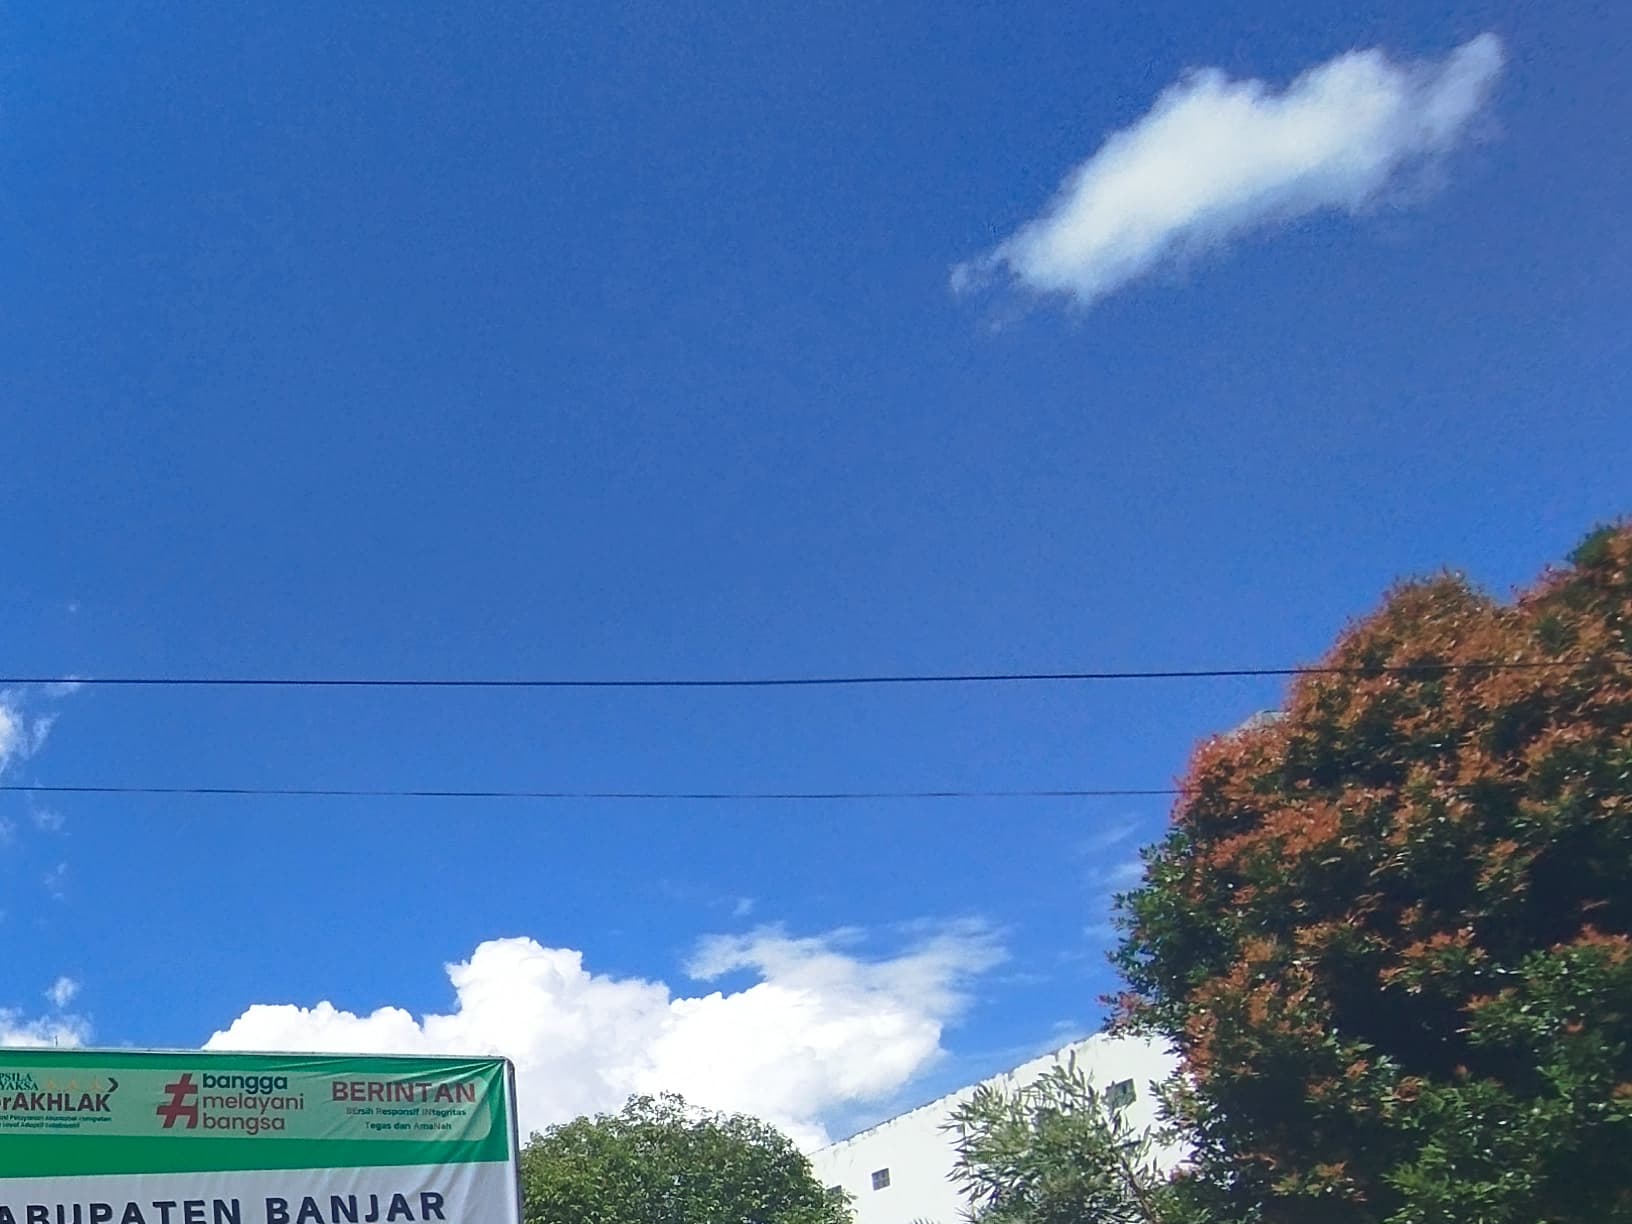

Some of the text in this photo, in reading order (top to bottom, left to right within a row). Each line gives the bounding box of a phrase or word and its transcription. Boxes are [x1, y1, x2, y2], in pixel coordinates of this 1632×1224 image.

[202, 1073, 288, 1095] bangga
[331, 1080, 476, 1104] BERINTAN
[202, 1092, 305, 1115] melayani
[202, 1112, 286, 1135] bangsa
[393, 1121, 412, 1131] dan
